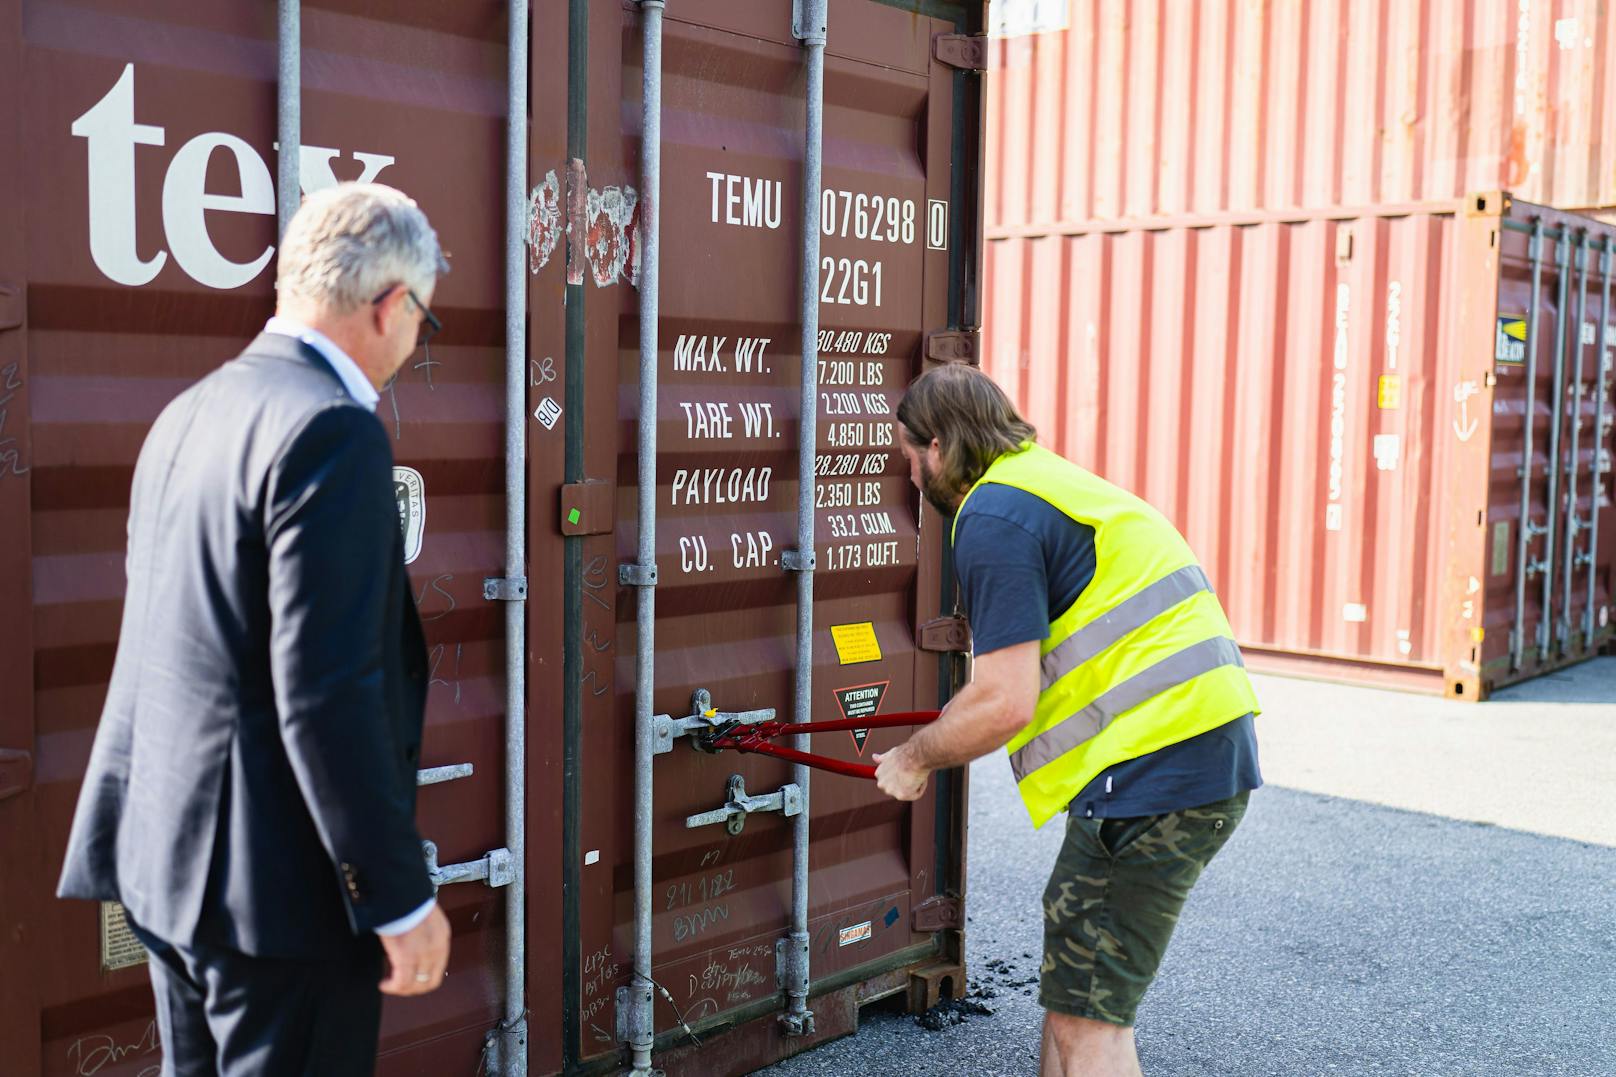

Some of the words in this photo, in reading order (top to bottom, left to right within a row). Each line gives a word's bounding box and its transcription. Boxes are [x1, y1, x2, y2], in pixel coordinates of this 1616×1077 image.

[706, 171, 782, 229] TEMU
[822, 189, 915, 244] 076298
[931, 203, 945, 247] 0
[821, 256, 882, 307] 22G1
[673, 334, 727, 372] MAX.
[734, 337, 771, 373] WT.
[863, 332, 892, 354] KGS
[818, 361, 854, 385] 7,200
[859, 362, 883, 386] LBS
[680, 402, 733, 439] TARE
[739, 402, 780, 438] WT.
[862, 393, 890, 414] KGS
[828, 423, 864, 447] 4,850
[869, 422, 893, 446] LBS
[399, 471, 419, 518] VERITAS
[671, 467, 772, 505] PAYLOAD
[860, 453, 889, 474] KGS
[816, 483, 852, 508] 2,350
[857, 482, 881, 505] LBS
[679, 535, 714, 573] CU.
[731, 531, 778, 569] CAP.
[827, 514, 860, 537] 33.2
[827, 544, 861, 570] 1,173
[867, 541, 900, 566] CU.FT.
[845, 687, 879, 702] ATTENTION
